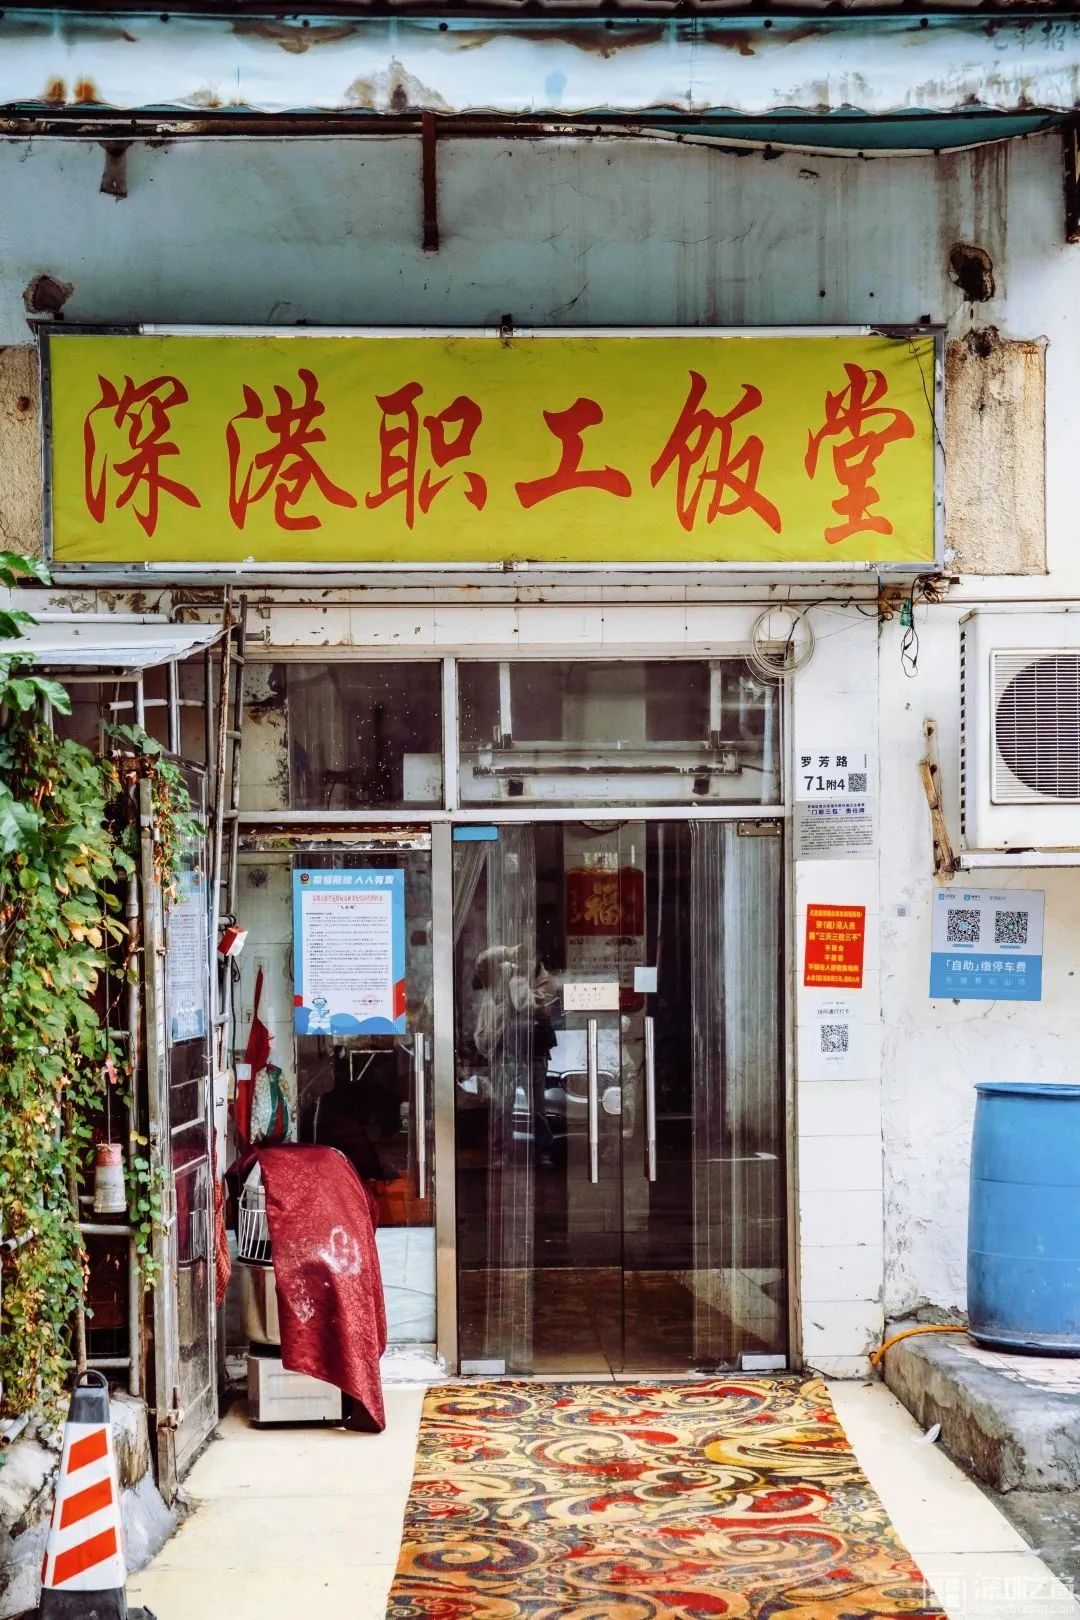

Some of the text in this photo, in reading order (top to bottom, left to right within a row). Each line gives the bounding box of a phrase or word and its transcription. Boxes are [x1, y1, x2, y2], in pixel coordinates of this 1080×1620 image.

[83, 361, 915, 543] 深港职工饭堂
[801, 755, 848, 768] 罗芳路
[804, 775, 846, 791] 71附4
